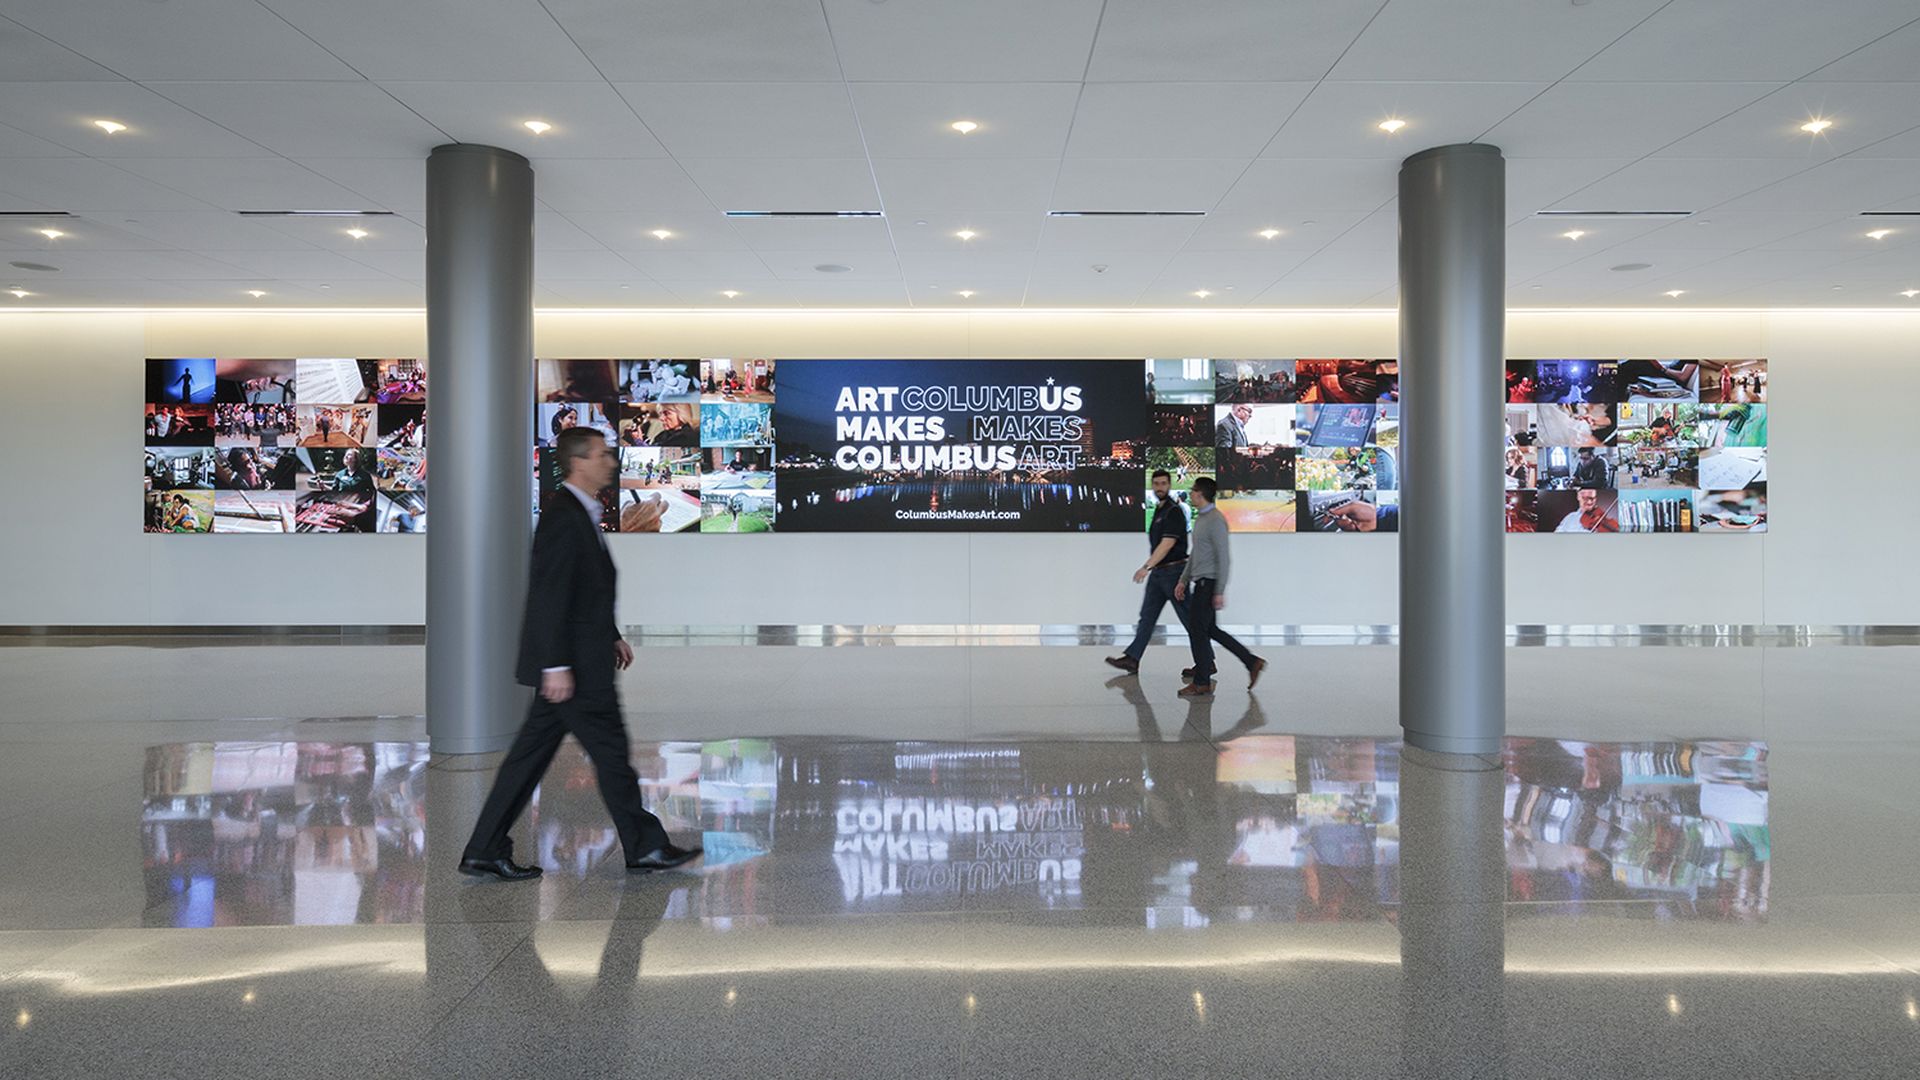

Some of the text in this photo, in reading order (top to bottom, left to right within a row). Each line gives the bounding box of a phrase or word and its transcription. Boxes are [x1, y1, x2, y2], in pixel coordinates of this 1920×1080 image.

[835, 386, 1082, 411] ART COLUMBUS
[836, 416, 1082, 441] MAKES MAKES
[835, 445, 1082, 471] COLUMBUS ART
[895, 509, 1021, 520] ColumbusMakesArt.com
